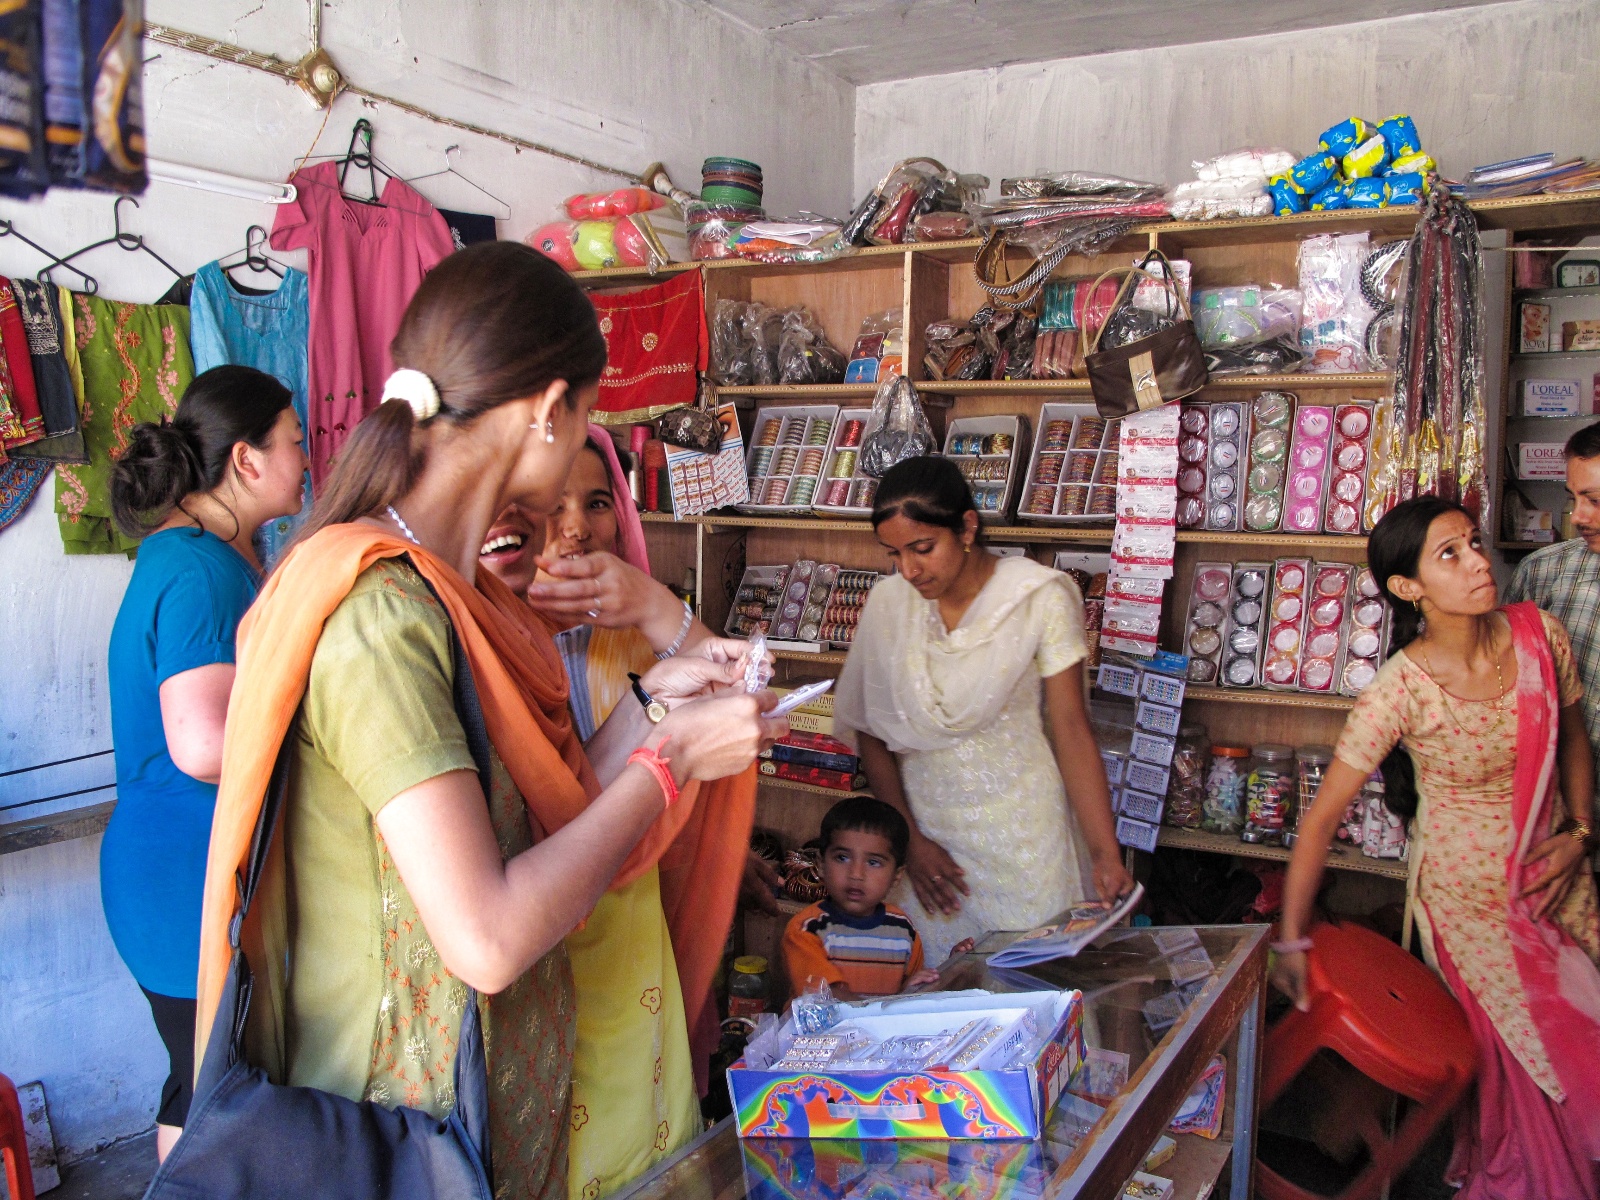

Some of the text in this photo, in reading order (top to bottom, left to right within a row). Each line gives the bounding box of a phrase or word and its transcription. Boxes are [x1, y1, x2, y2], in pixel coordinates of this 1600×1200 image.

[1524, 340, 1546, 349] NOVA
[1532, 385, 1574, 395] L'OREAL
[1526, 448, 1566, 458] L'OREA
